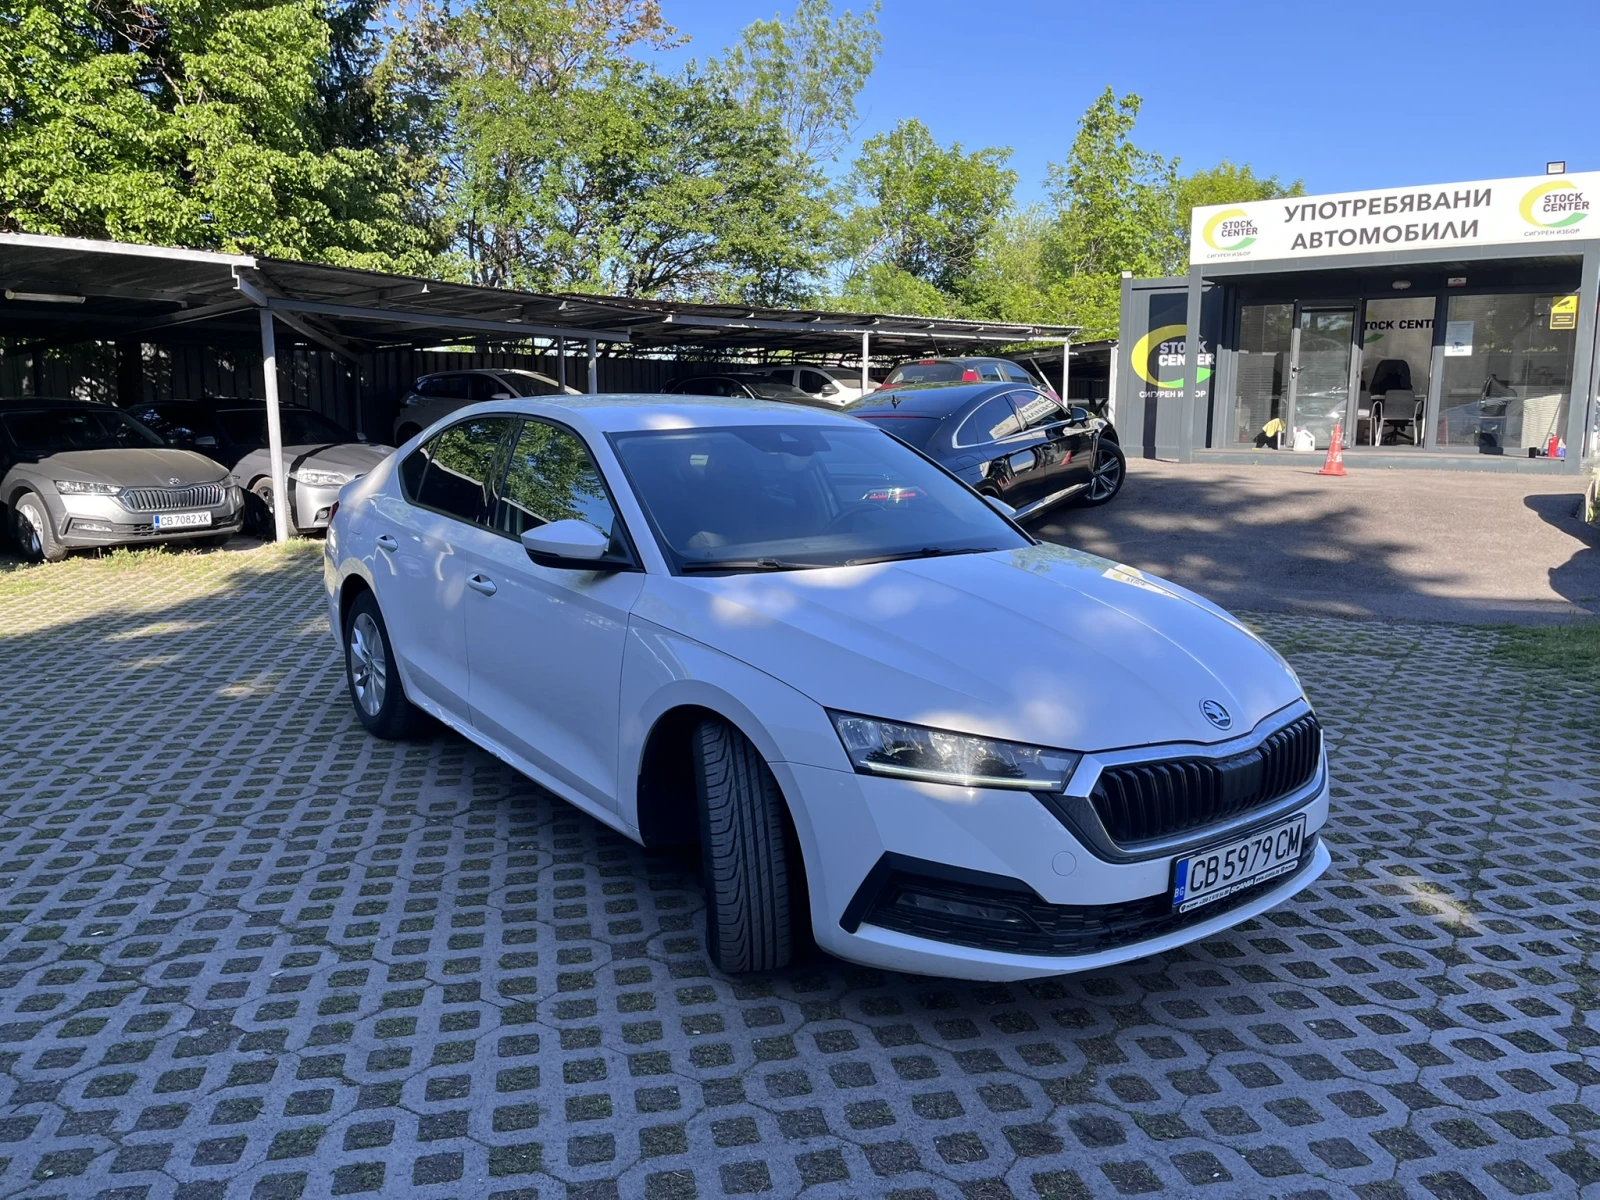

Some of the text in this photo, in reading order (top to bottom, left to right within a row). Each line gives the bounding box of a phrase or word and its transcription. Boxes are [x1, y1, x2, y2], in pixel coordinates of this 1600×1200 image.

[1543, 192, 1583, 203] STOCK
[1284, 188, 1492, 223] УПОТРЕБЯВАНИ
[1543, 201, 1590, 212] CENTER
[1222, 219, 1253, 230] STOCK
[1221, 227, 1258, 238] CENTER
[1290, 219, 1479, 250] АВТОМОБИЛИ
[1365, 319, 1435, 330] TOCK CENT
[1159, 341, 1207, 354] STOK
[1158, 353, 1215, 366] CENER
[1139, 390, 1206, 398] СИГУРЕН ИОР
[1174, 886, 1185, 898] BG
